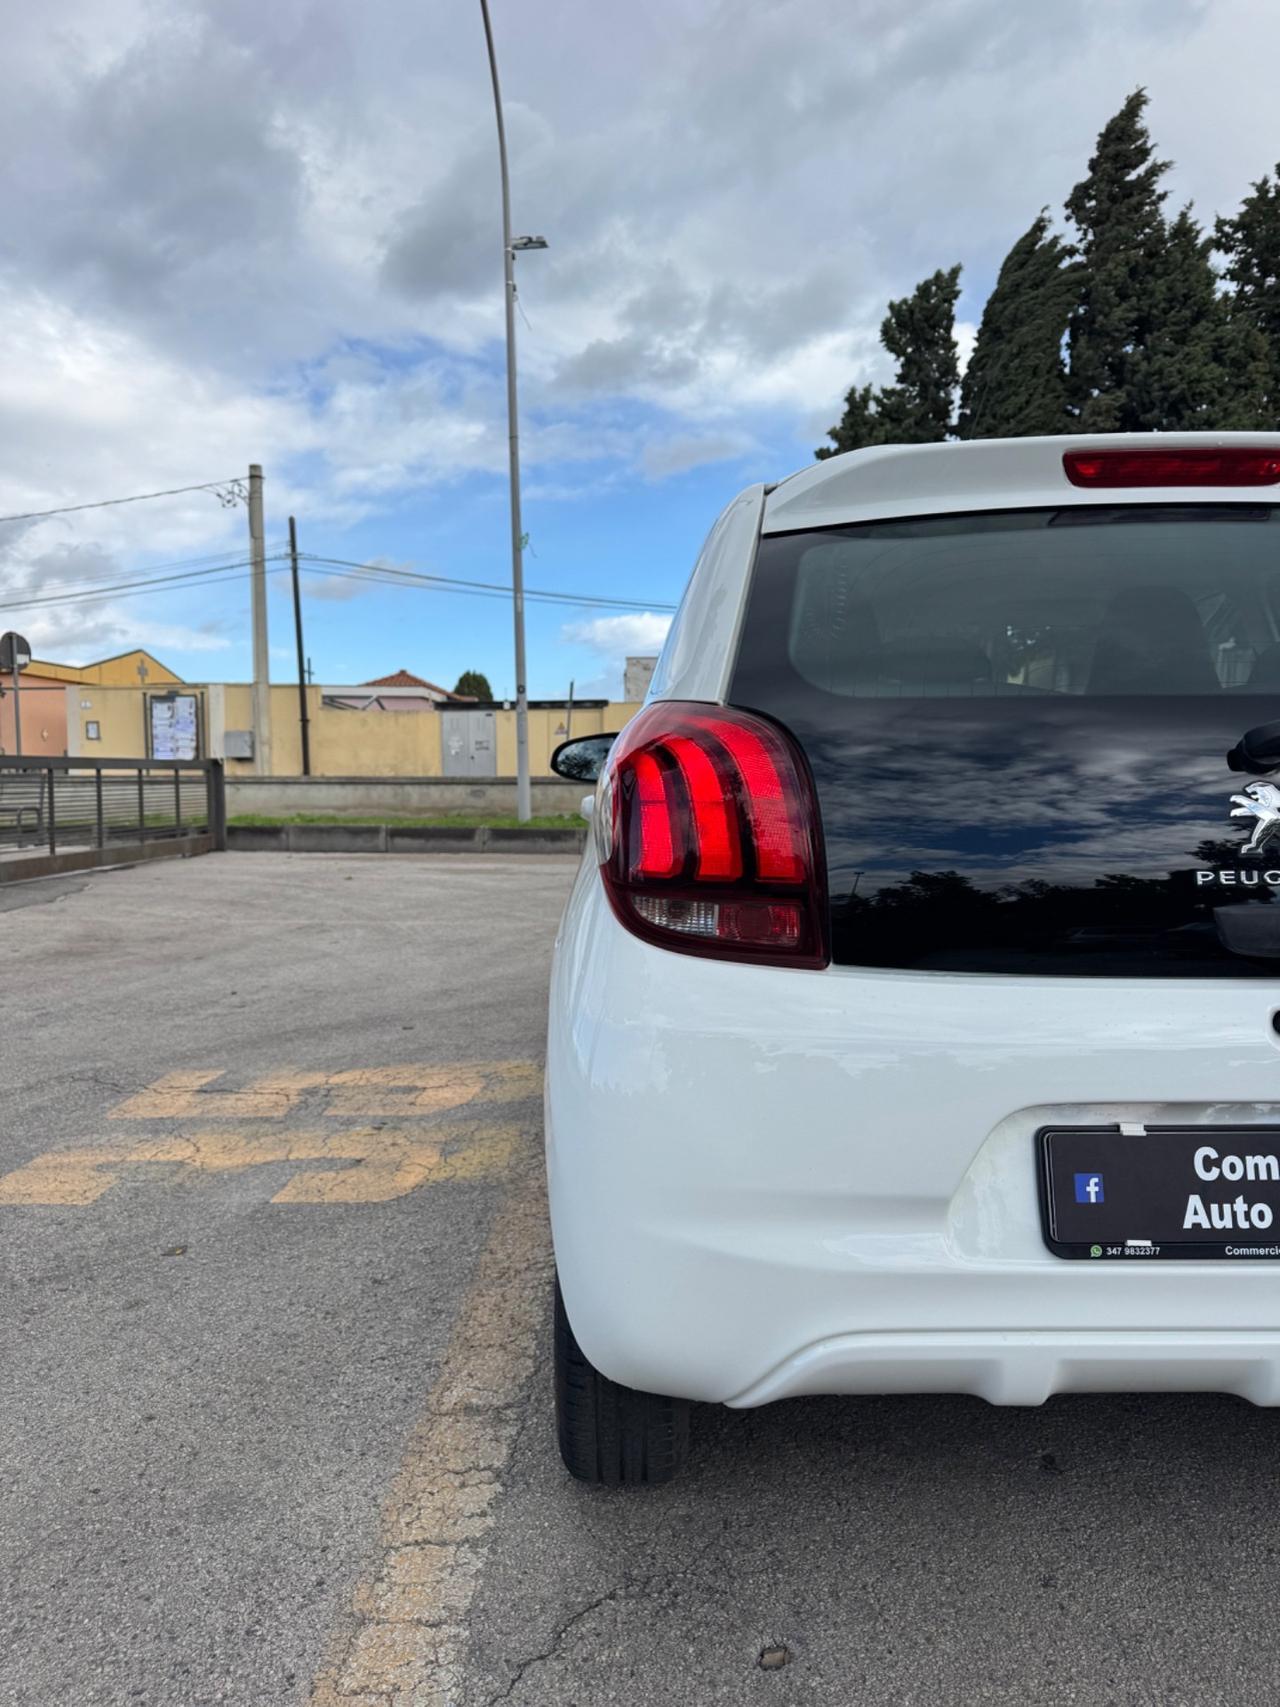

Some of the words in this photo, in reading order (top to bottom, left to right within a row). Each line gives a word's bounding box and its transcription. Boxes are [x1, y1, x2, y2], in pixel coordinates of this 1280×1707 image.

[1182, 1194, 1274, 1230] Auto
[1106, 1247, 1122, 1256] 347
[1124, 1247, 1161, 1256] 9832377
[1225, 1245, 1280, 1256] Commerci
